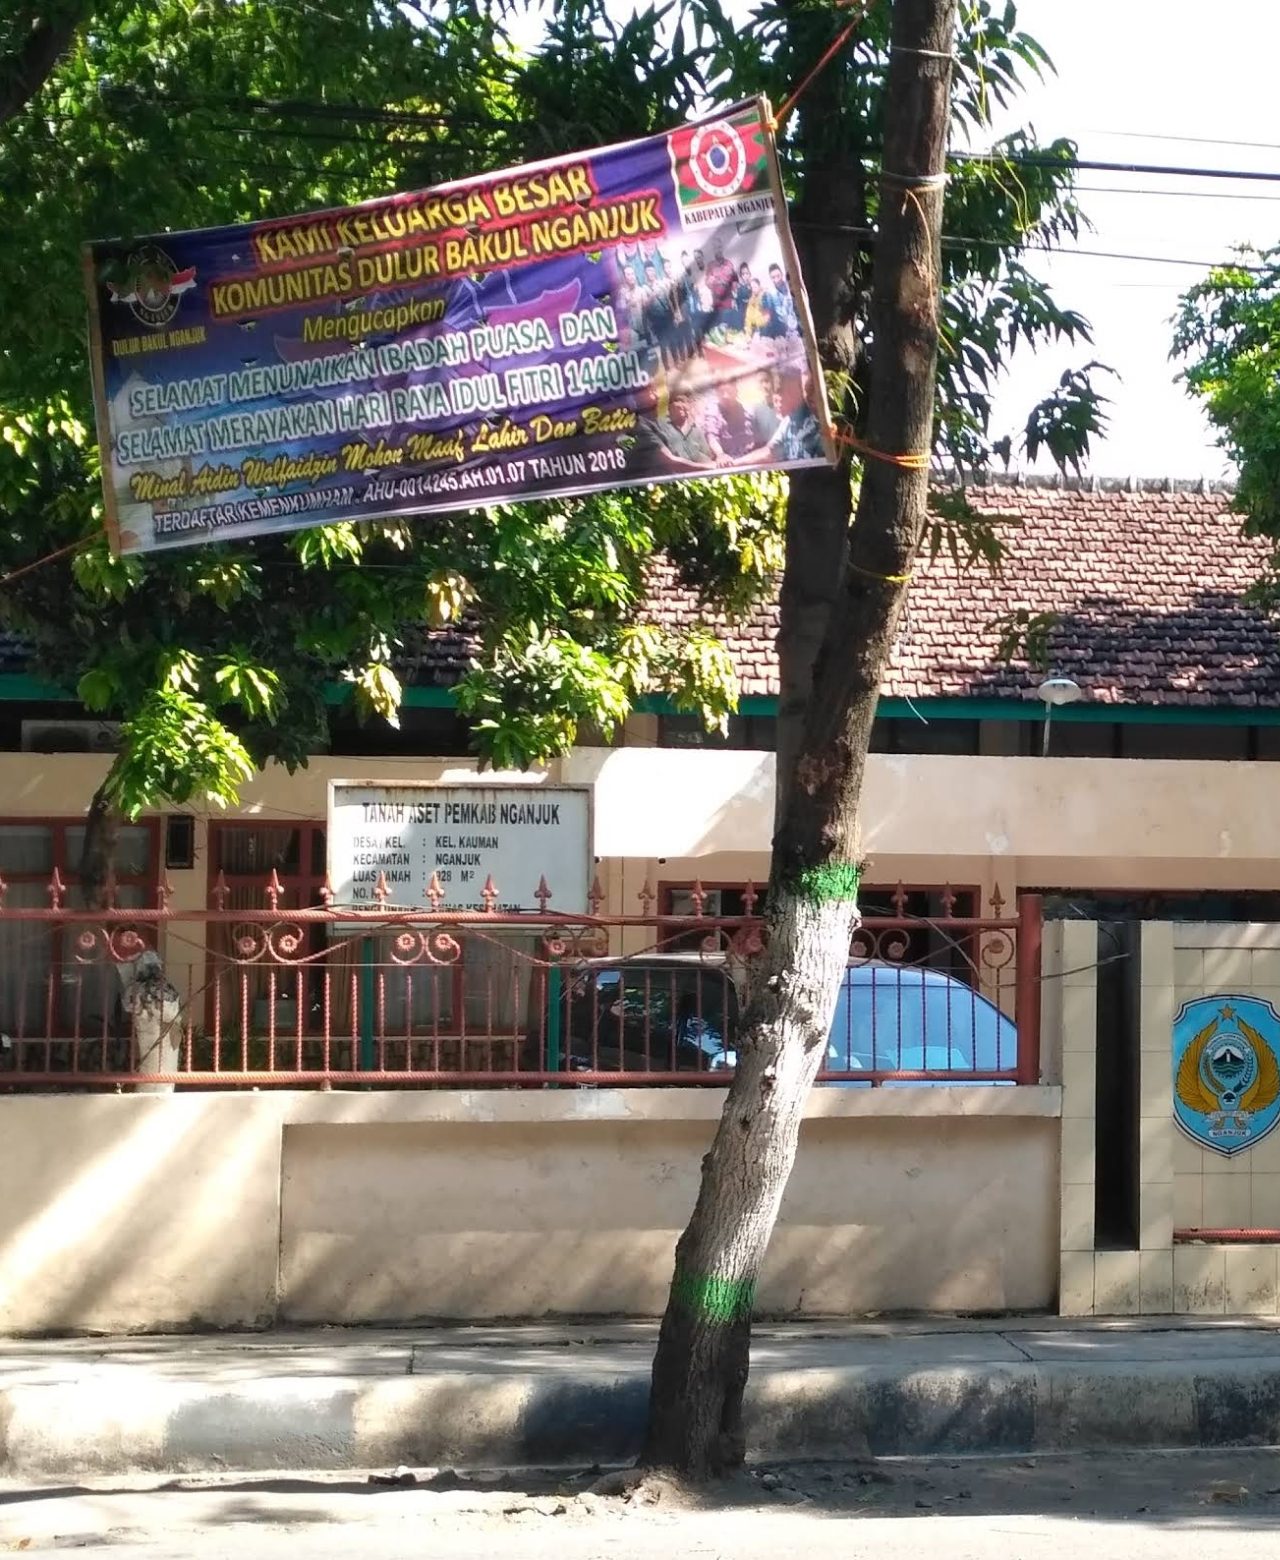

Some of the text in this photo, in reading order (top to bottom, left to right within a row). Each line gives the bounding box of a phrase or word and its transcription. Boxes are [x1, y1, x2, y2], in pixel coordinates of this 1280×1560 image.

[256, 166, 593, 263] KAMI KELUARGA BESAR
[684, 205, 736, 225] KABUPATEN
[212, 262, 352, 313] KOMUNITAS
[358, 246, 440, 287] DULUR
[446, 227, 528, 270] BAKUL
[532, 199, 661, 253] NGANJUK
[303, 299, 445, 342] Mengucapkan
[132, 309, 616, 414] SELAMAT MENUNAIKAN IBADAH PUASA DAN
[119, 353, 648, 463] SELAMAT MERAYAKAN HARI RAYA IDUL FITRI 1440H.
[131, 406, 637, 500] Minal Aidin Walfaidzin Mohon Maaf Lahir Dan Batin
[154, 504, 237, 532] TERDAFTAR
[238, 487, 354, 520] KEMENKUMHAM
[363, 461, 526, 502] AHU-0014245.AH.01.07
[528, 456, 587, 479] TAHUN
[590, 448, 626, 473] 2018
[362, 802, 560, 825] TANAH ASET PEMKAB NGANJUK
[353, 836, 378, 848] DESA
[385, 836, 405, 848] KEL.
[459, 836, 498, 849] KAUMAN
[353, 853, 410, 865] KECAMATAN
[435, 853, 481, 865] NGANJUK
[353, 870, 376, 882] LUAS
[380, 870, 411, 882] ANAH
[353, 887, 368, 899] NO.
